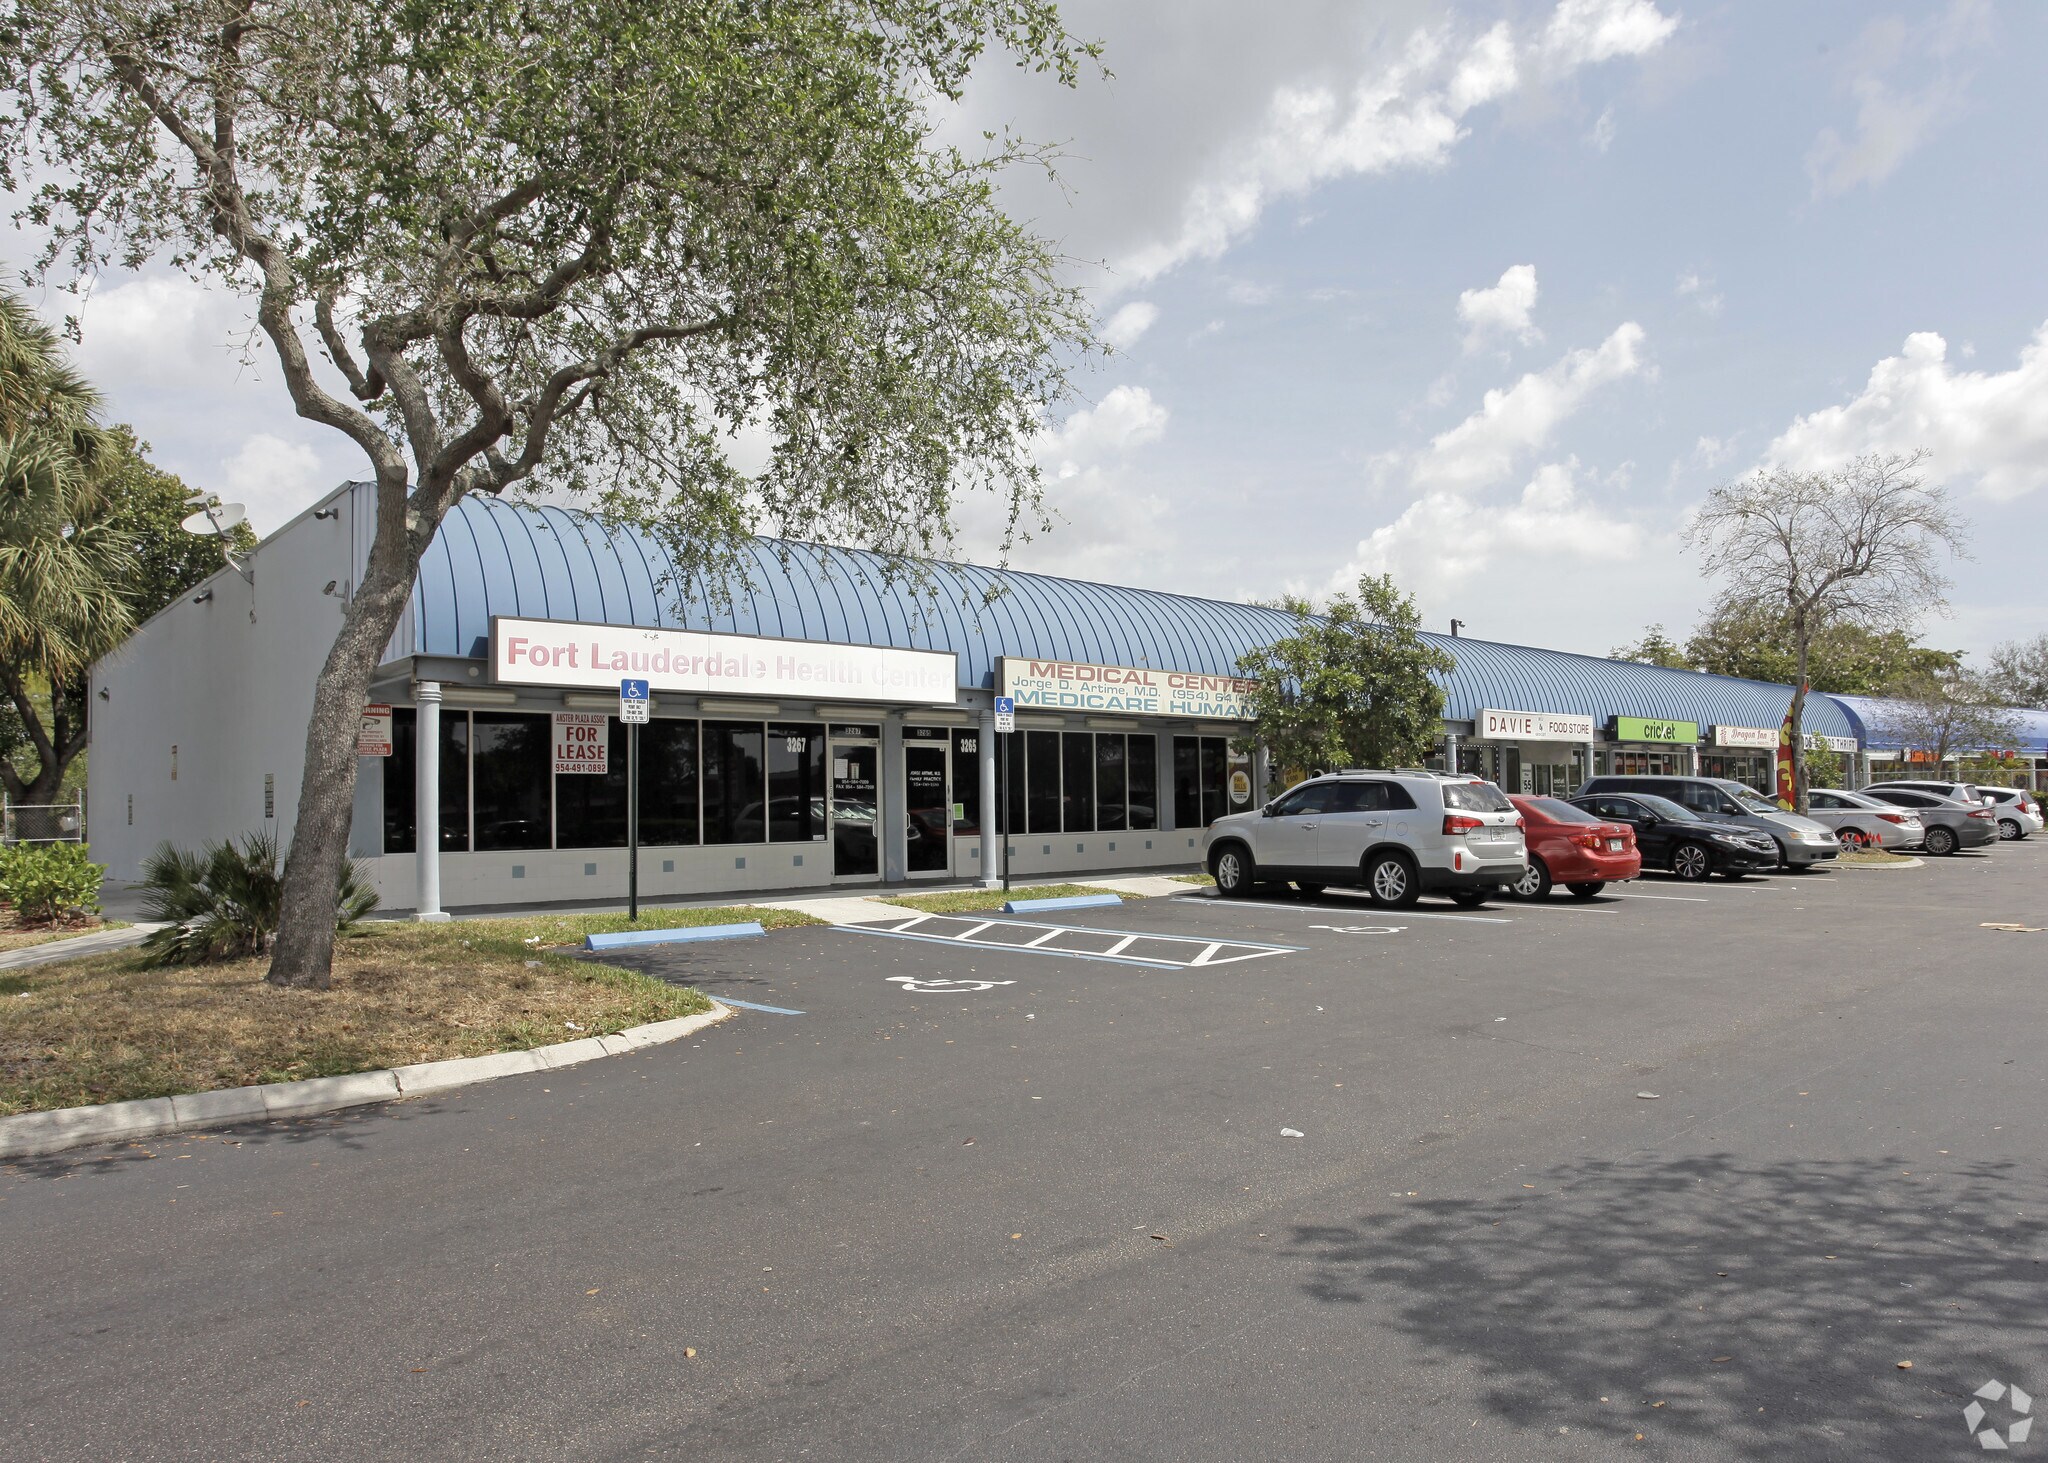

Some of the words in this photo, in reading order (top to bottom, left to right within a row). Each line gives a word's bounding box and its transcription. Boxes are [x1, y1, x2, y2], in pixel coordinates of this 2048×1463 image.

[508, 637, 579, 669] Fort
[591, 643, 767, 679] Lauderdale
[776, 655, 862, 684] Health
[871, 664, 951, 689] Center
[1029, 662, 1156, 687] MEDICAL
[1012, 676, 1052, 691] Jorge
[1059, 680, 1073, 690] D.
[1080, 682, 1129, 696] Artime,
[1134, 686, 1161, 697] M.D.
[1172, 689, 1209, 701] (954)
[1014, 689, 1158, 712] MEDICARE
[556, 713, 575, 723] ANSTER
[575, 714, 590, 723] PLAZA
[591, 715, 606, 724] ASSOC
[1489, 716, 1532, 734] DAVIE
[1549, 721, 1568, 734] FOOD
[1568, 723, 1589, 734] STORE
[566, 726, 598, 742] FOR
[1643, 721, 1676, 740] cricket
[1731, 728, 1756, 742] Dragon
[1756, 730, 1768, 740] Inn
[557, 744, 605, 760] LEASE
[786, 737, 807, 753] 3267
[960, 738, 977, 753] 3265
[1836, 738, 1855, 750] THRIFT
[555, 763, 606, 773] 954-491-0892
[1523, 780, 1532, 790] 55
